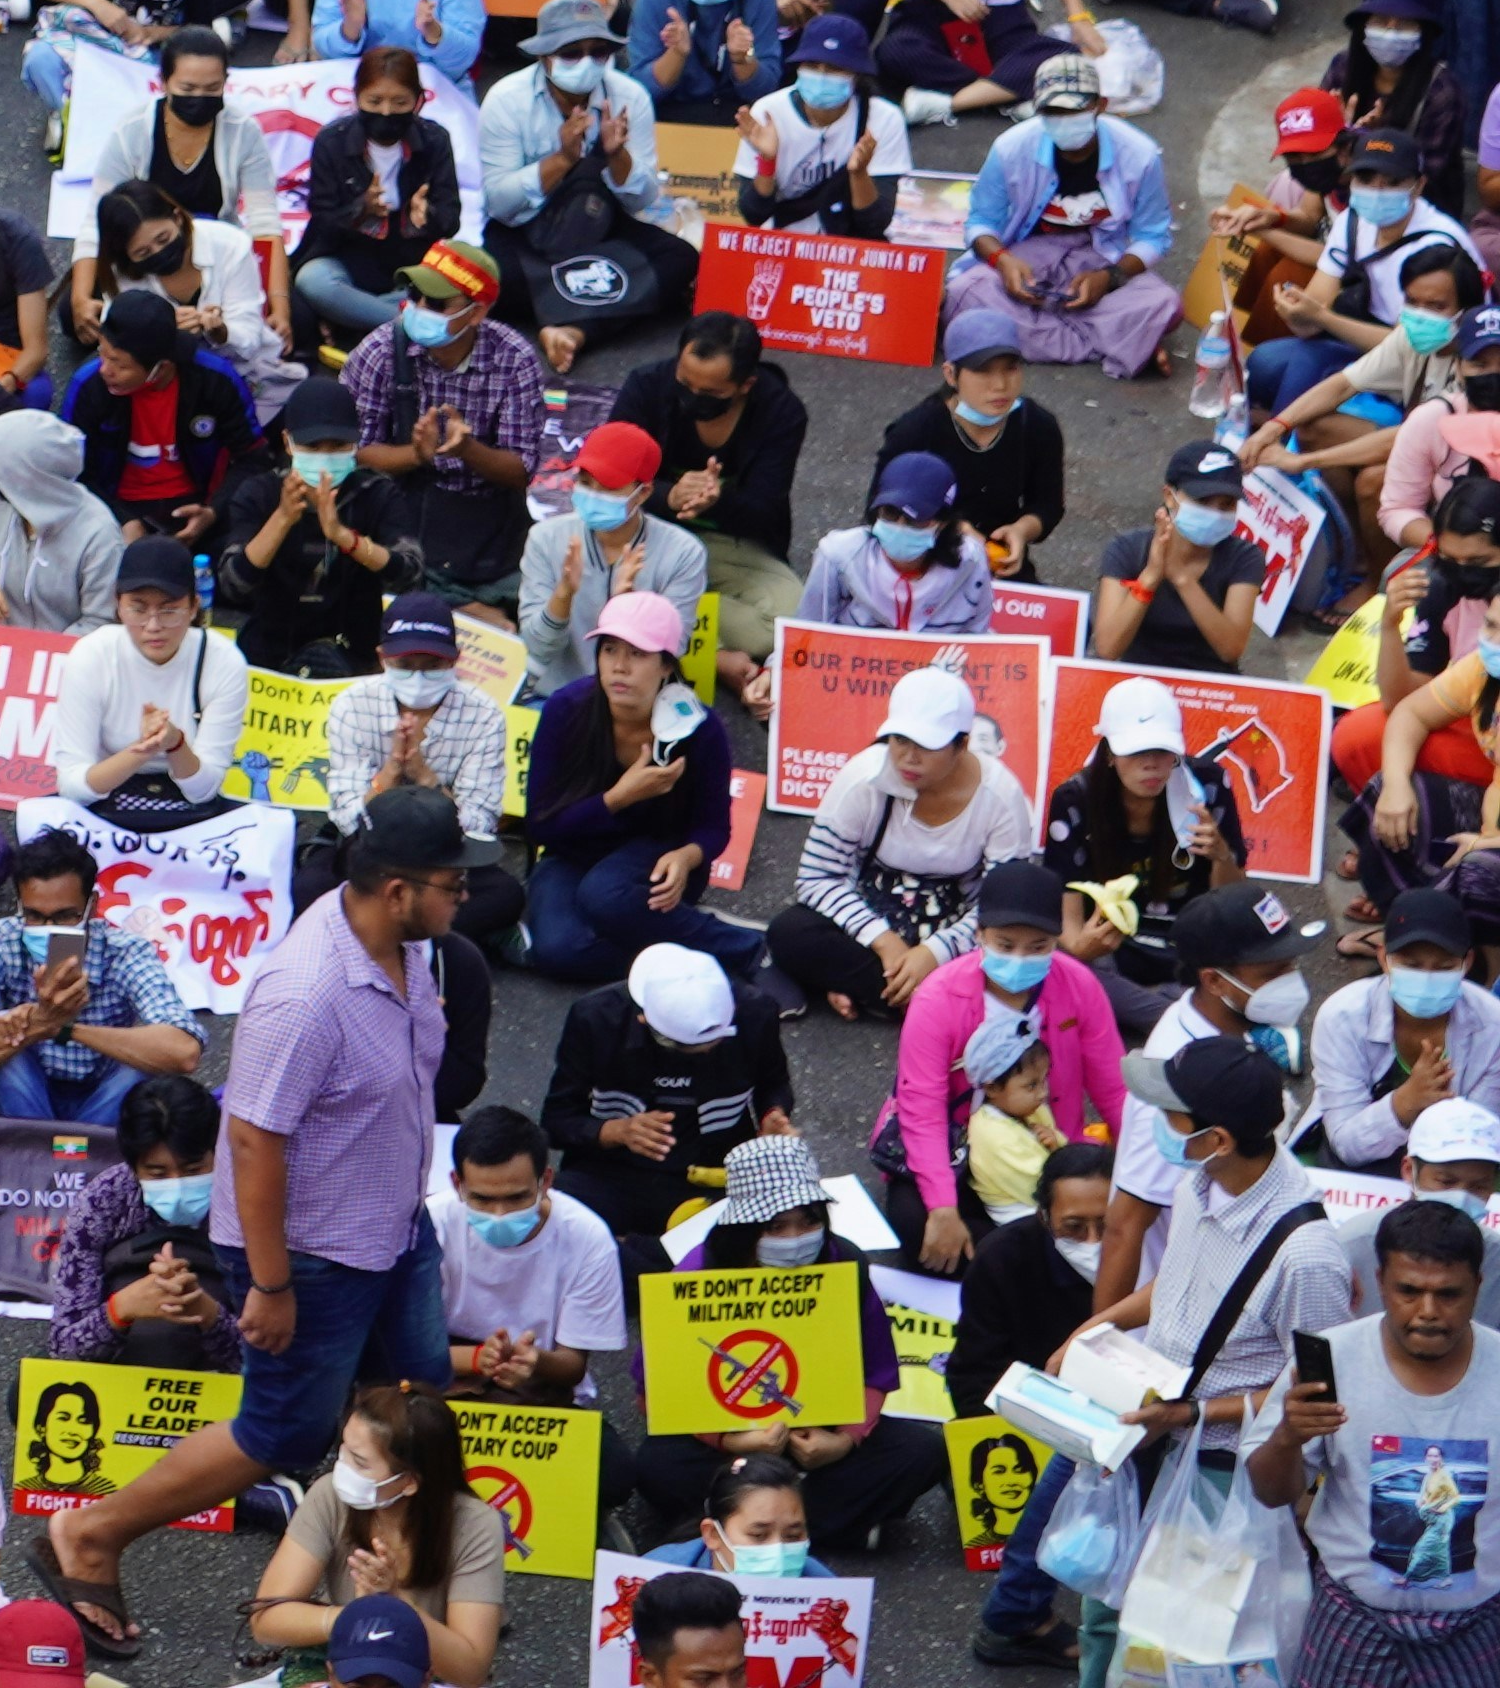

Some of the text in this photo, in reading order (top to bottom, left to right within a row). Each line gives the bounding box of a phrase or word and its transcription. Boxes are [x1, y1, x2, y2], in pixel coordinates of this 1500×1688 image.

[719, 233, 929, 274] WE REJECT MILITARY JUNTA BY
[820, 269, 859, 292] THE
[790, 287, 886, 315] PEOPLE'S
[809, 309, 861, 333] VETO
[1004, 598, 1047, 620] OUR
[791, 648, 853, 675] OUR
[1003, 662, 1028, 682] IS
[251, 676, 303, 704] Don't
[821, 674, 893, 700] U WIN
[781, 748, 849, 768] PLEASE
[782, 764, 844, 783] TO STO
[53, 1172, 86, 1190] WE
[34, 1190, 75, 1209] NOT
[673, 1273, 825, 1299] WE DON'T ACCEPT
[688, 1297, 817, 1324] MILITARY COUP
[143, 1376, 204, 1396] FREE
[148, 1396, 197, 1415] OUR
[501, 1415, 568, 1438] ACCEPT
[511, 1439, 558, 1461] COUP
[26, 1493, 88, 1512] FIGHT
